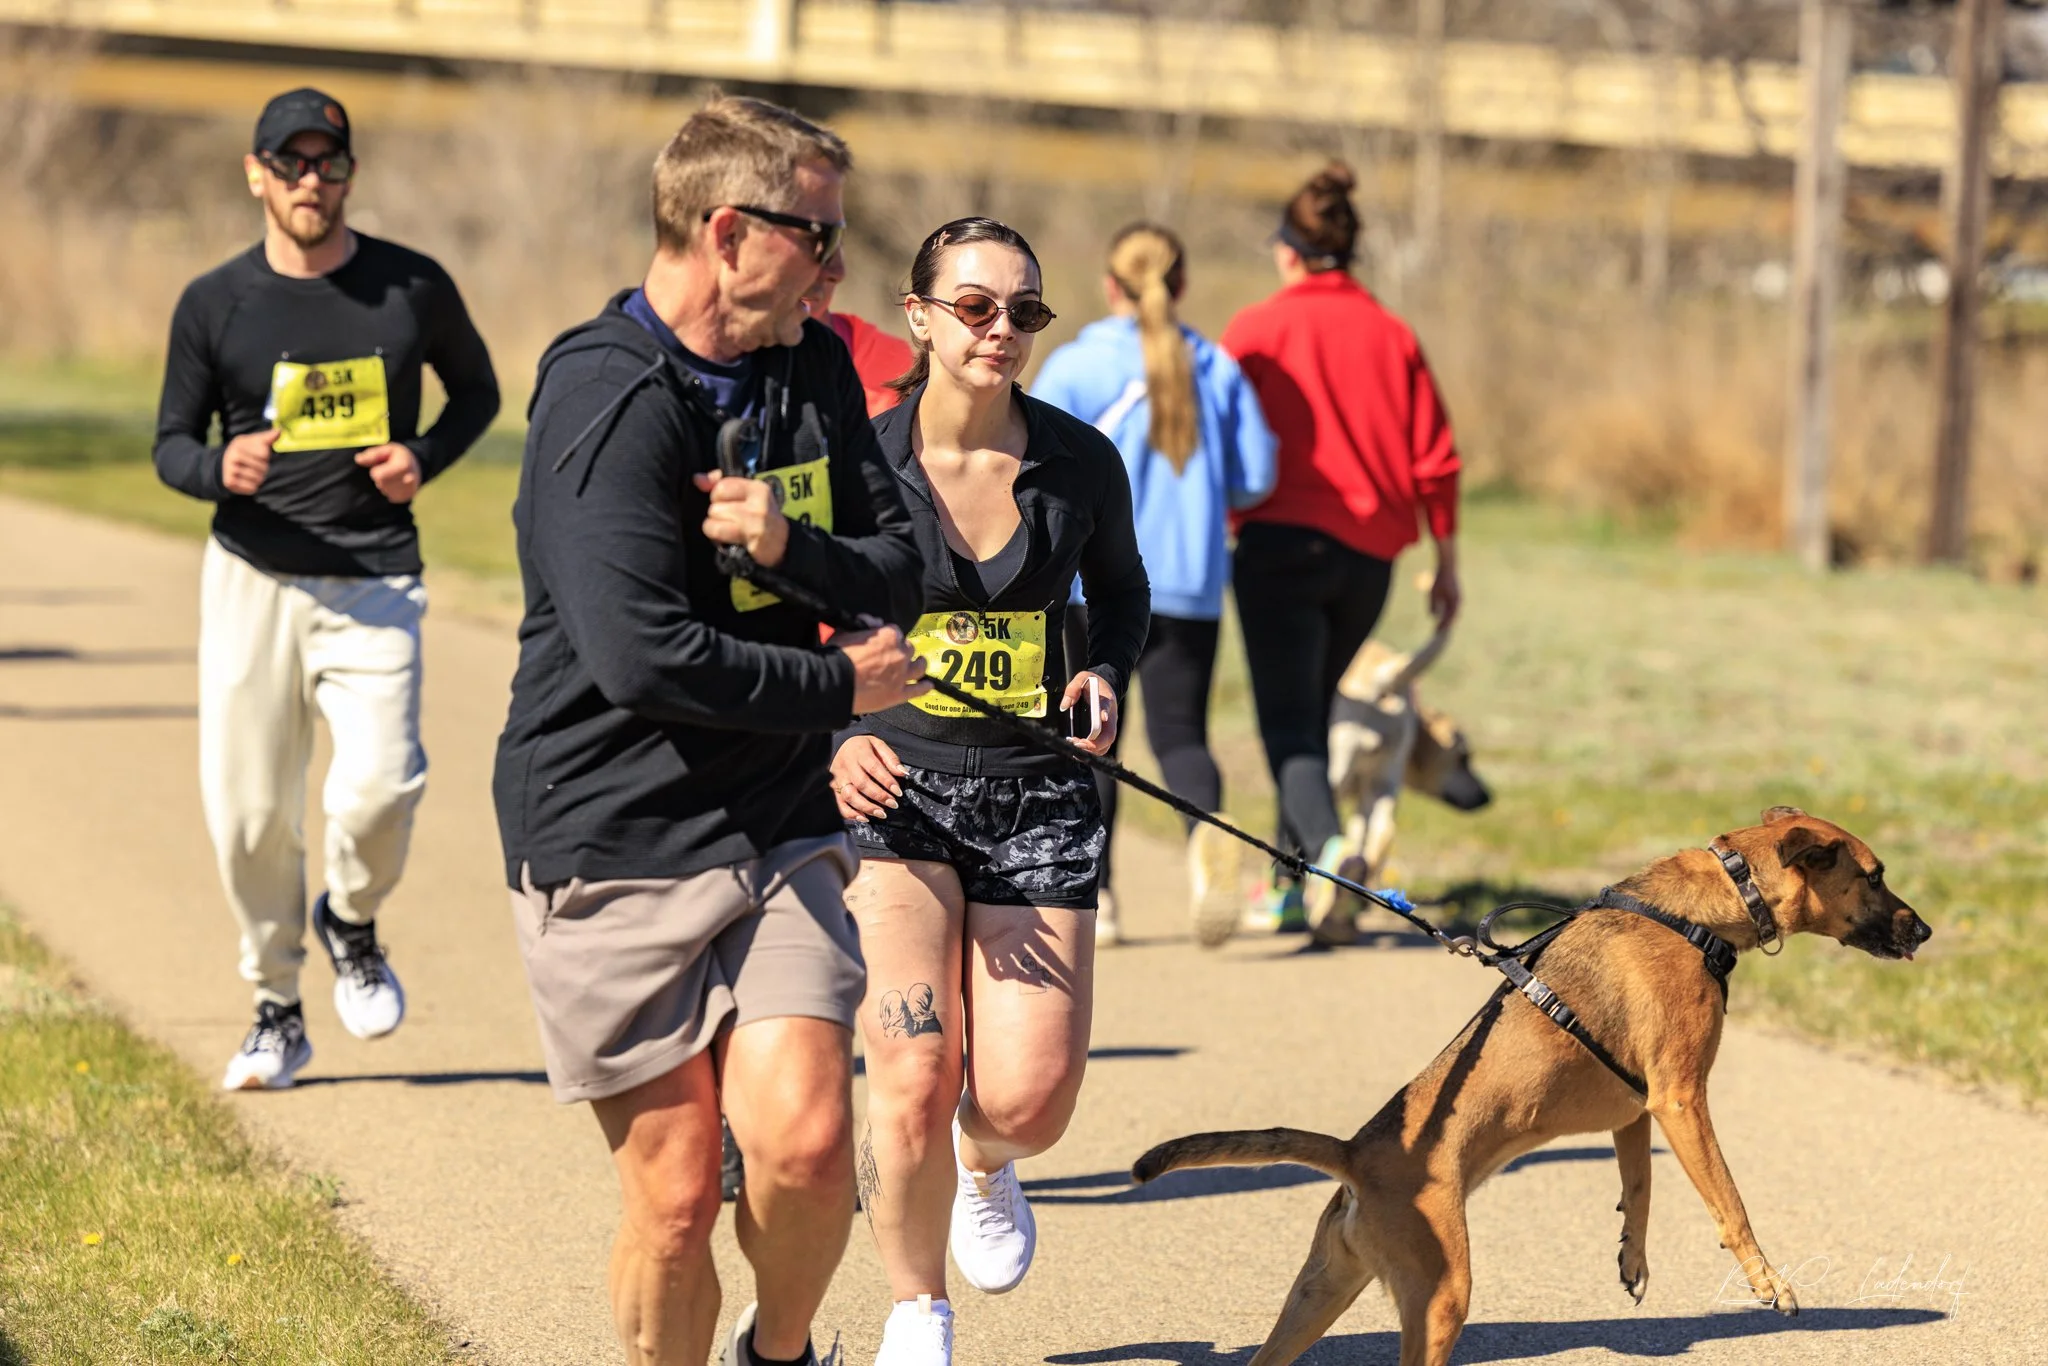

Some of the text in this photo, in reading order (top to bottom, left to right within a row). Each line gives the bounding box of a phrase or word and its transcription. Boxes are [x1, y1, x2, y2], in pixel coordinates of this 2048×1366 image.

[333, 368, 353, 385] 5K
[300, 392, 355, 419] 439
[789, 473, 814, 500] 5K
[985, 618, 1012, 639] 5K
[941, 649, 1012, 690] 249
[925, 702, 939, 711] Good
[940, 704, 948, 712] for
[1016, 701, 1029, 709] 249
